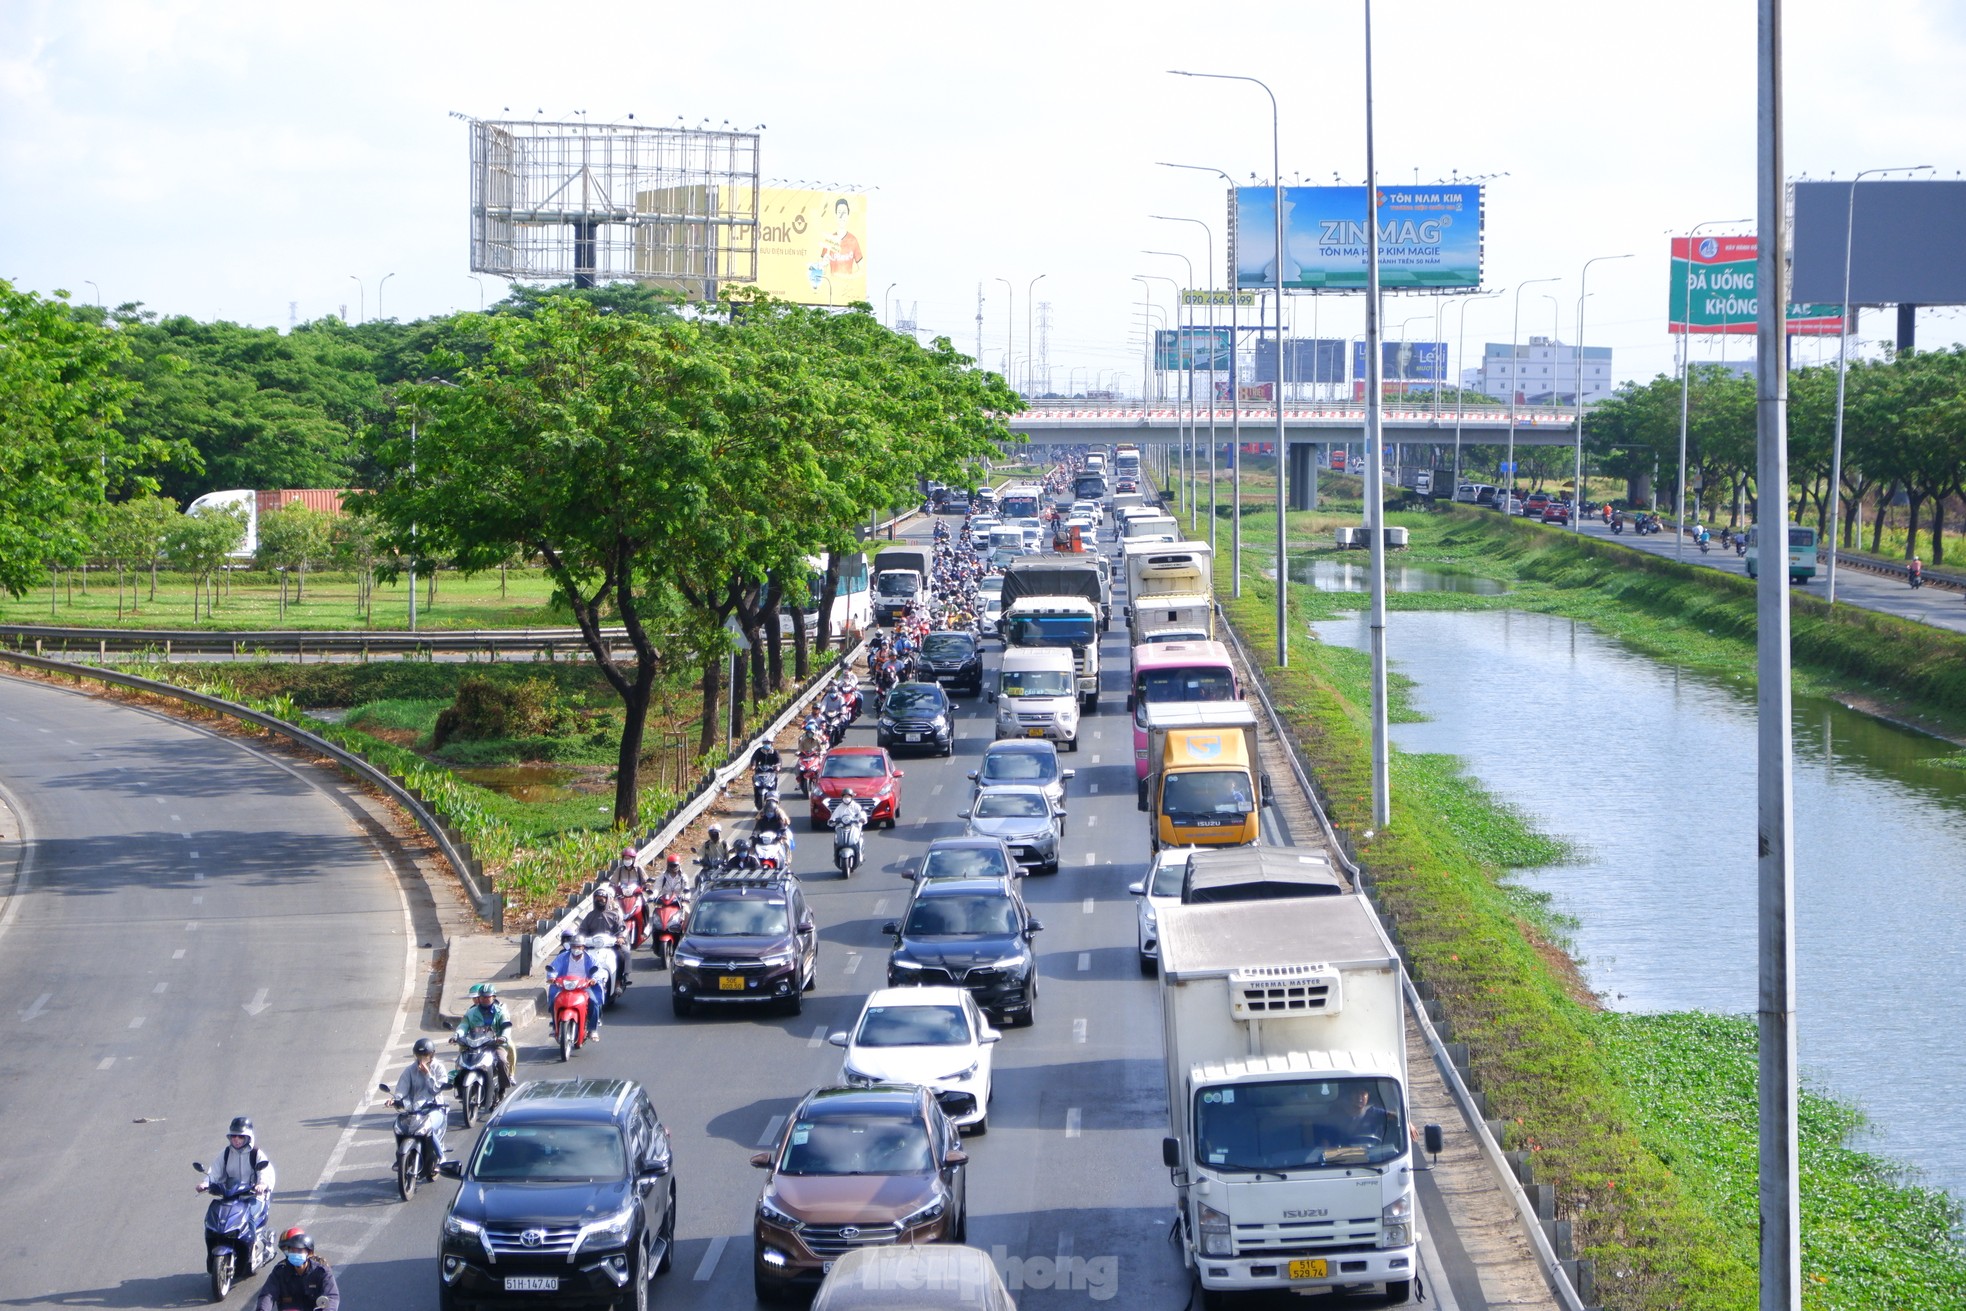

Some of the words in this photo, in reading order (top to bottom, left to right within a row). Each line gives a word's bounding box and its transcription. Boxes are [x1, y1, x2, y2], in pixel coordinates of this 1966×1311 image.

[1390, 192, 1412, 203] TÔN
[1415, 193, 1440, 203] NAM
[1443, 193, 1462, 203] KIM
[1319, 246, 1340, 256] TÔN
[1343, 247, 1359, 258] MẠ
[1361, 247, 1385, 256] HP
[1386, 247, 1406, 256] KIM
[1408, 246, 1440, 256] MAGIE
[1711, 268, 1754, 290] UỐNG
[1185, 295, 1204, 305] 090
[1705, 293, 1757, 315] KHÔNG
[1250, 981, 1287, 989] THERMAL
[1289, 979, 1320, 987] MASTER
[1283, 1208, 1328, 1218] ISUZU
[1299, 1260, 1316, 1269] 51C
[1293, 1269, 1324, 1278] 529.74
